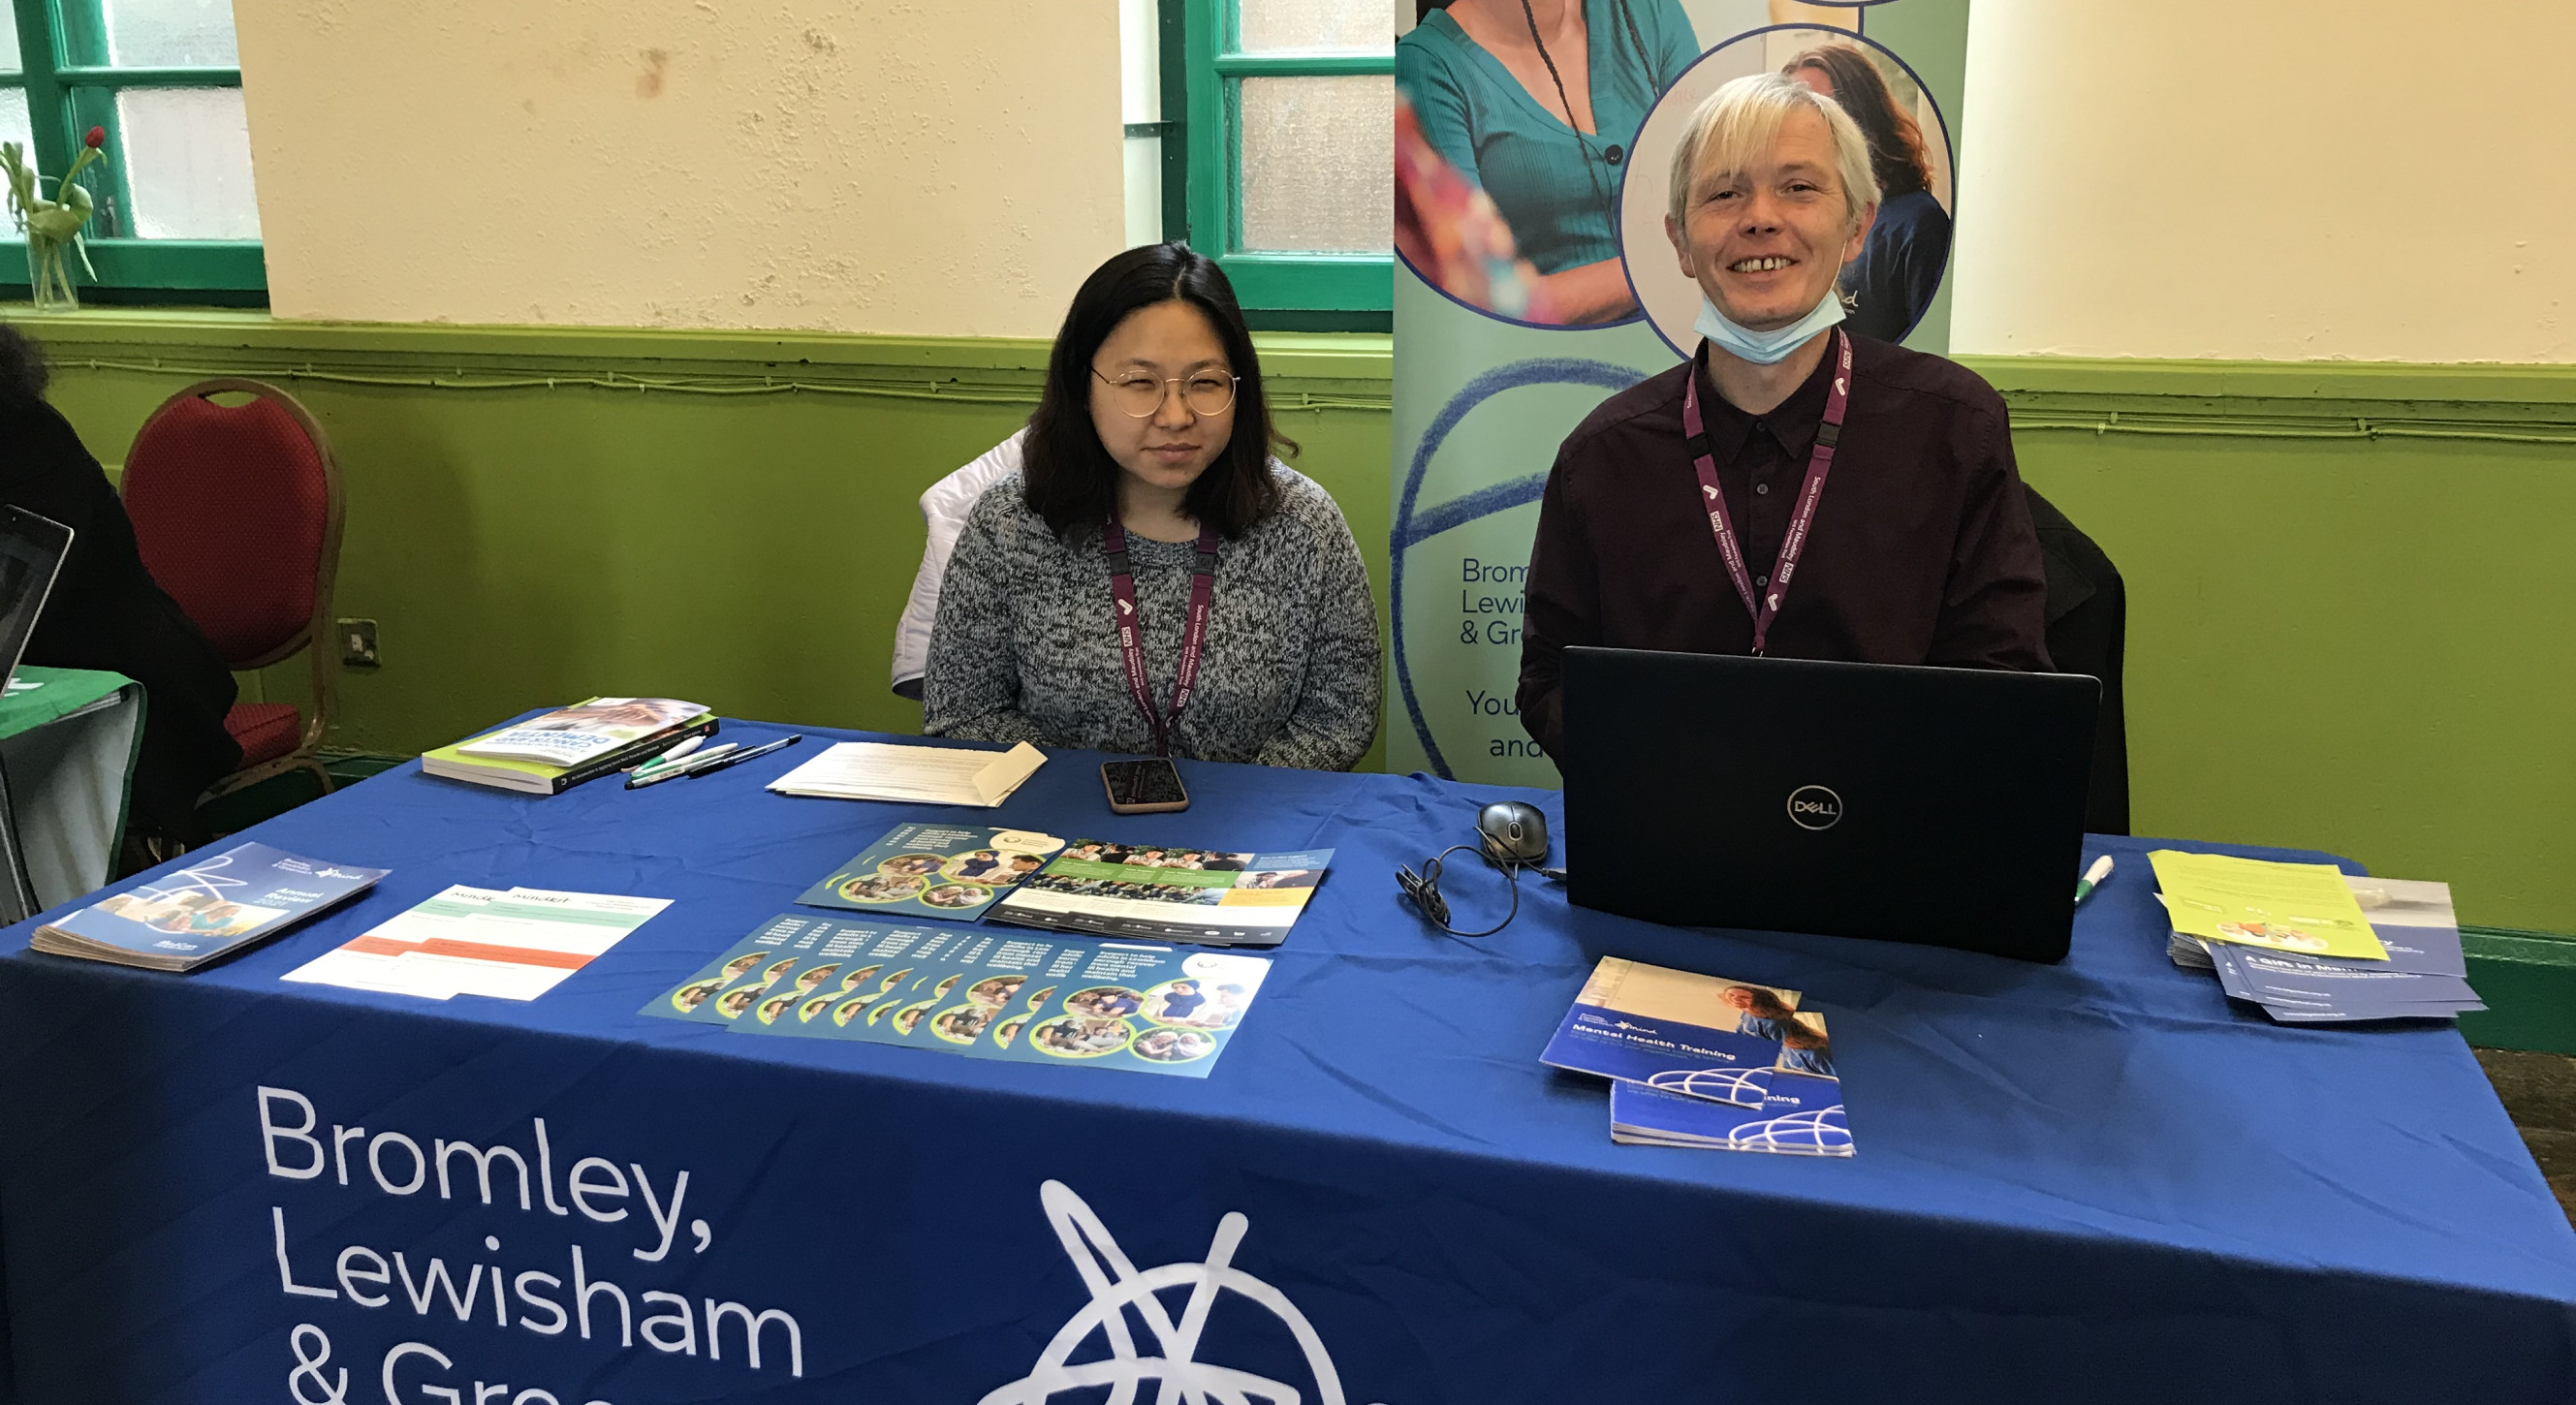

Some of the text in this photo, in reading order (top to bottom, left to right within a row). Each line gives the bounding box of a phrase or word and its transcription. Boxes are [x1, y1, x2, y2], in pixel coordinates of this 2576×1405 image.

[1809, 476, 1821, 494] South
[1802, 495, 1815, 518] London
[1711, 512, 1723, 531] NHS
[1786, 532, 1803, 561] Maudsley
[1779, 562, 1793, 582] NHS
[1462, 589, 1524, 613] Lewi
[1122, 627, 1132, 646] NHS
[1192, 622, 1201, 644] London
[1460, 619, 1523, 645] & Gr
[1178, 689, 1189, 706] NHS
[508, 731, 611, 745] DEMENTIA
[1795, 800, 1837, 815] DELL
[264, 892, 313, 903] Review
[275, 888, 325, 898] Annual
[2259, 958, 2293, 968] Gift
[1628, 1022, 1657, 1035] mind
[1572, 1023, 1622, 1039] Mental
[1626, 1034, 1676, 1048] Health
[1680, 1044, 1736, 1061] Training
[257, 1085, 712, 1262] Bromley,
[271, 1206, 802, 1378] Lewisham
[288, 1323, 349, 1405] &
